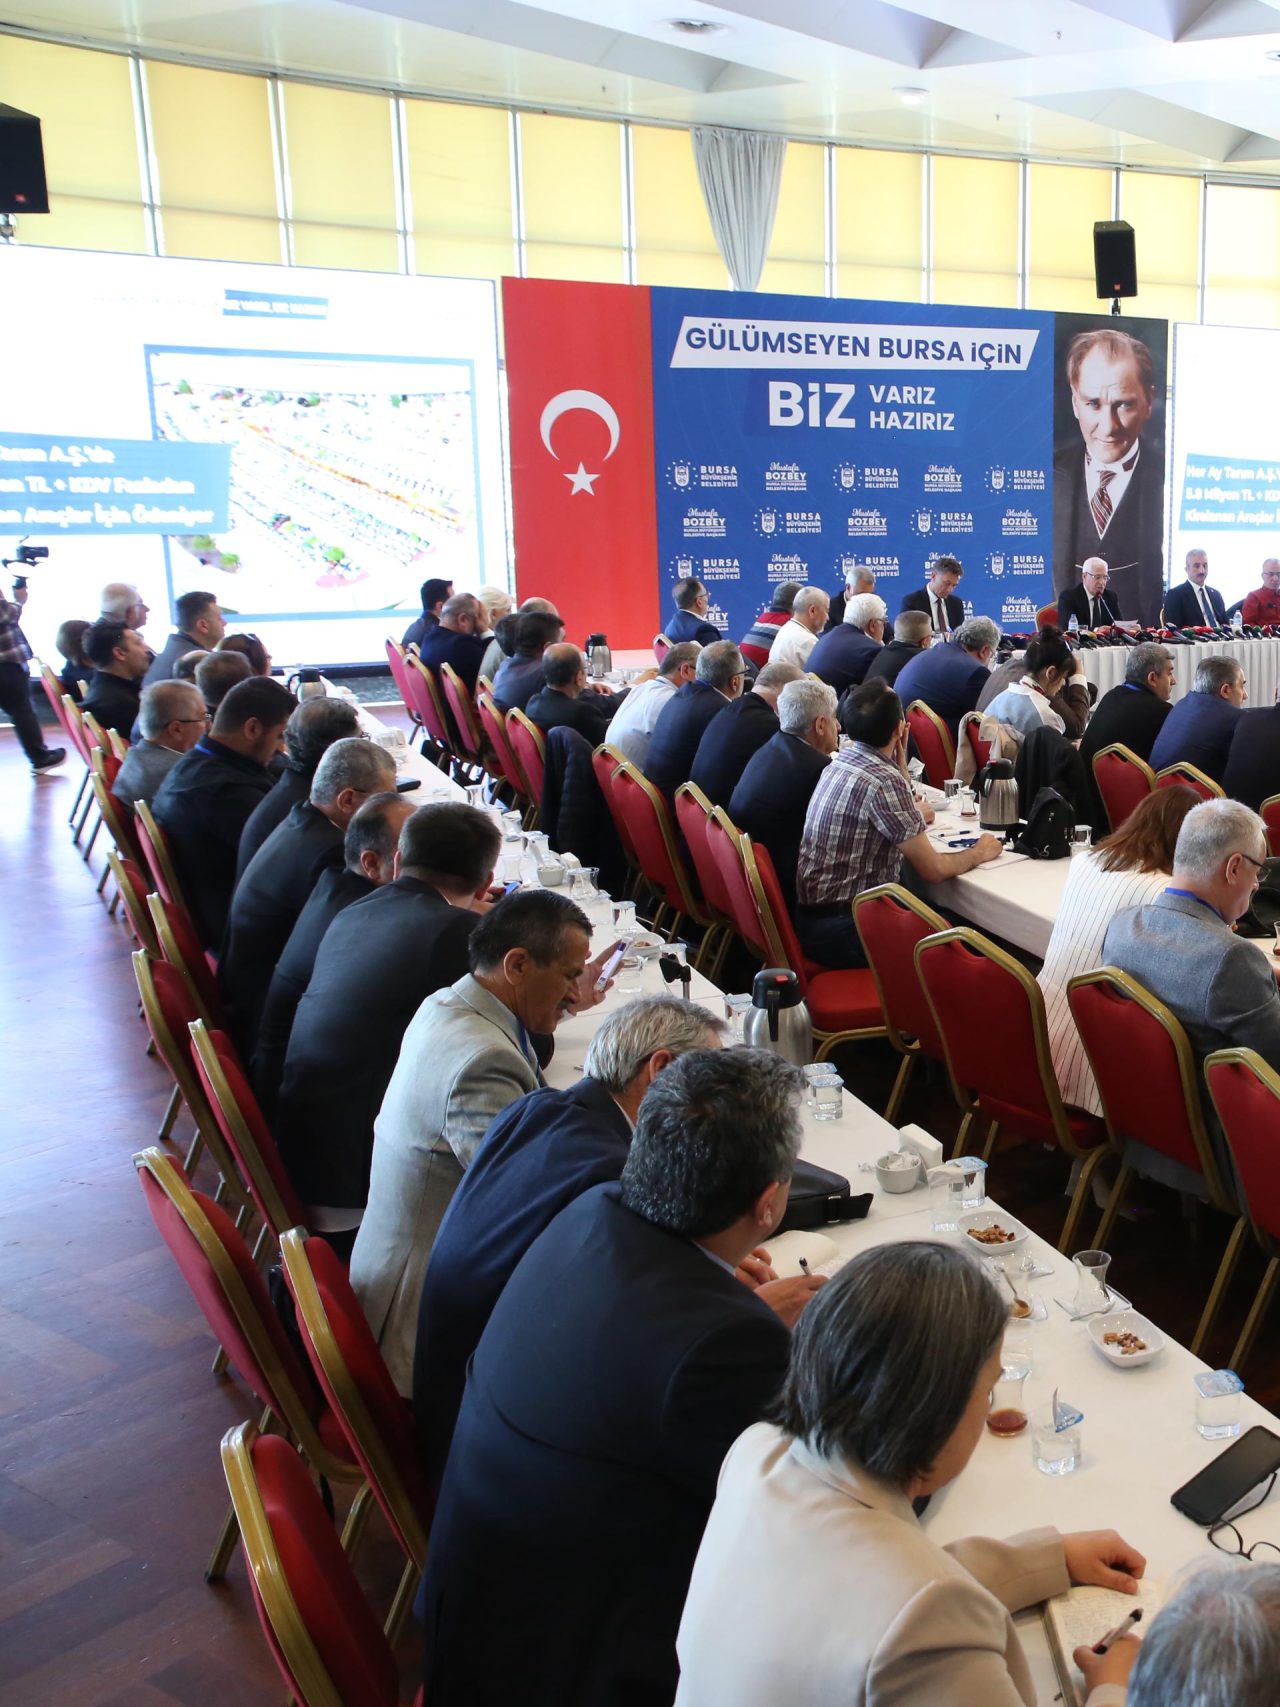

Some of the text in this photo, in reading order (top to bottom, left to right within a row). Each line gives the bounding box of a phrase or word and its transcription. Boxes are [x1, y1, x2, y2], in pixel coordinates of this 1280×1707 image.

[686, 323, 870, 357] GÜLÜMSEYEN
[879, 337, 964, 361] BURSA
[869, 385, 935, 405] VARIZ
[870, 411, 955, 431] HAZIRIZ
[701, 466, 737, 474] BURSA
[770, 462, 799, 473] Mustafa
[865, 468, 898, 476] BURSA
[928, 465, 955, 475] Mustafa
[766, 472, 806, 480] BOZBEY
[924, 474, 962, 482] BOZBEY
[1014, 470, 1045, 478] BURSA
[688, 508, 718, 518] Mustafa
[786, 513, 821, 521] BURSA
[852, 508, 880, 518] Mustafa
[1006, 509, 1032, 518] Mustafa
[683, 518, 725, 526] BOZBEY
[848, 518, 886, 526] BOZBEY
[704, 559, 740, 567] BURSA
[772, 554, 801, 564] Mustafa
[1014, 555, 1044, 563] BURSA
[768, 563, 808, 572] BOZBEY
[1006, 596, 1032, 605] Mustafa
[1002, 604, 1037, 613] BOZBEY
